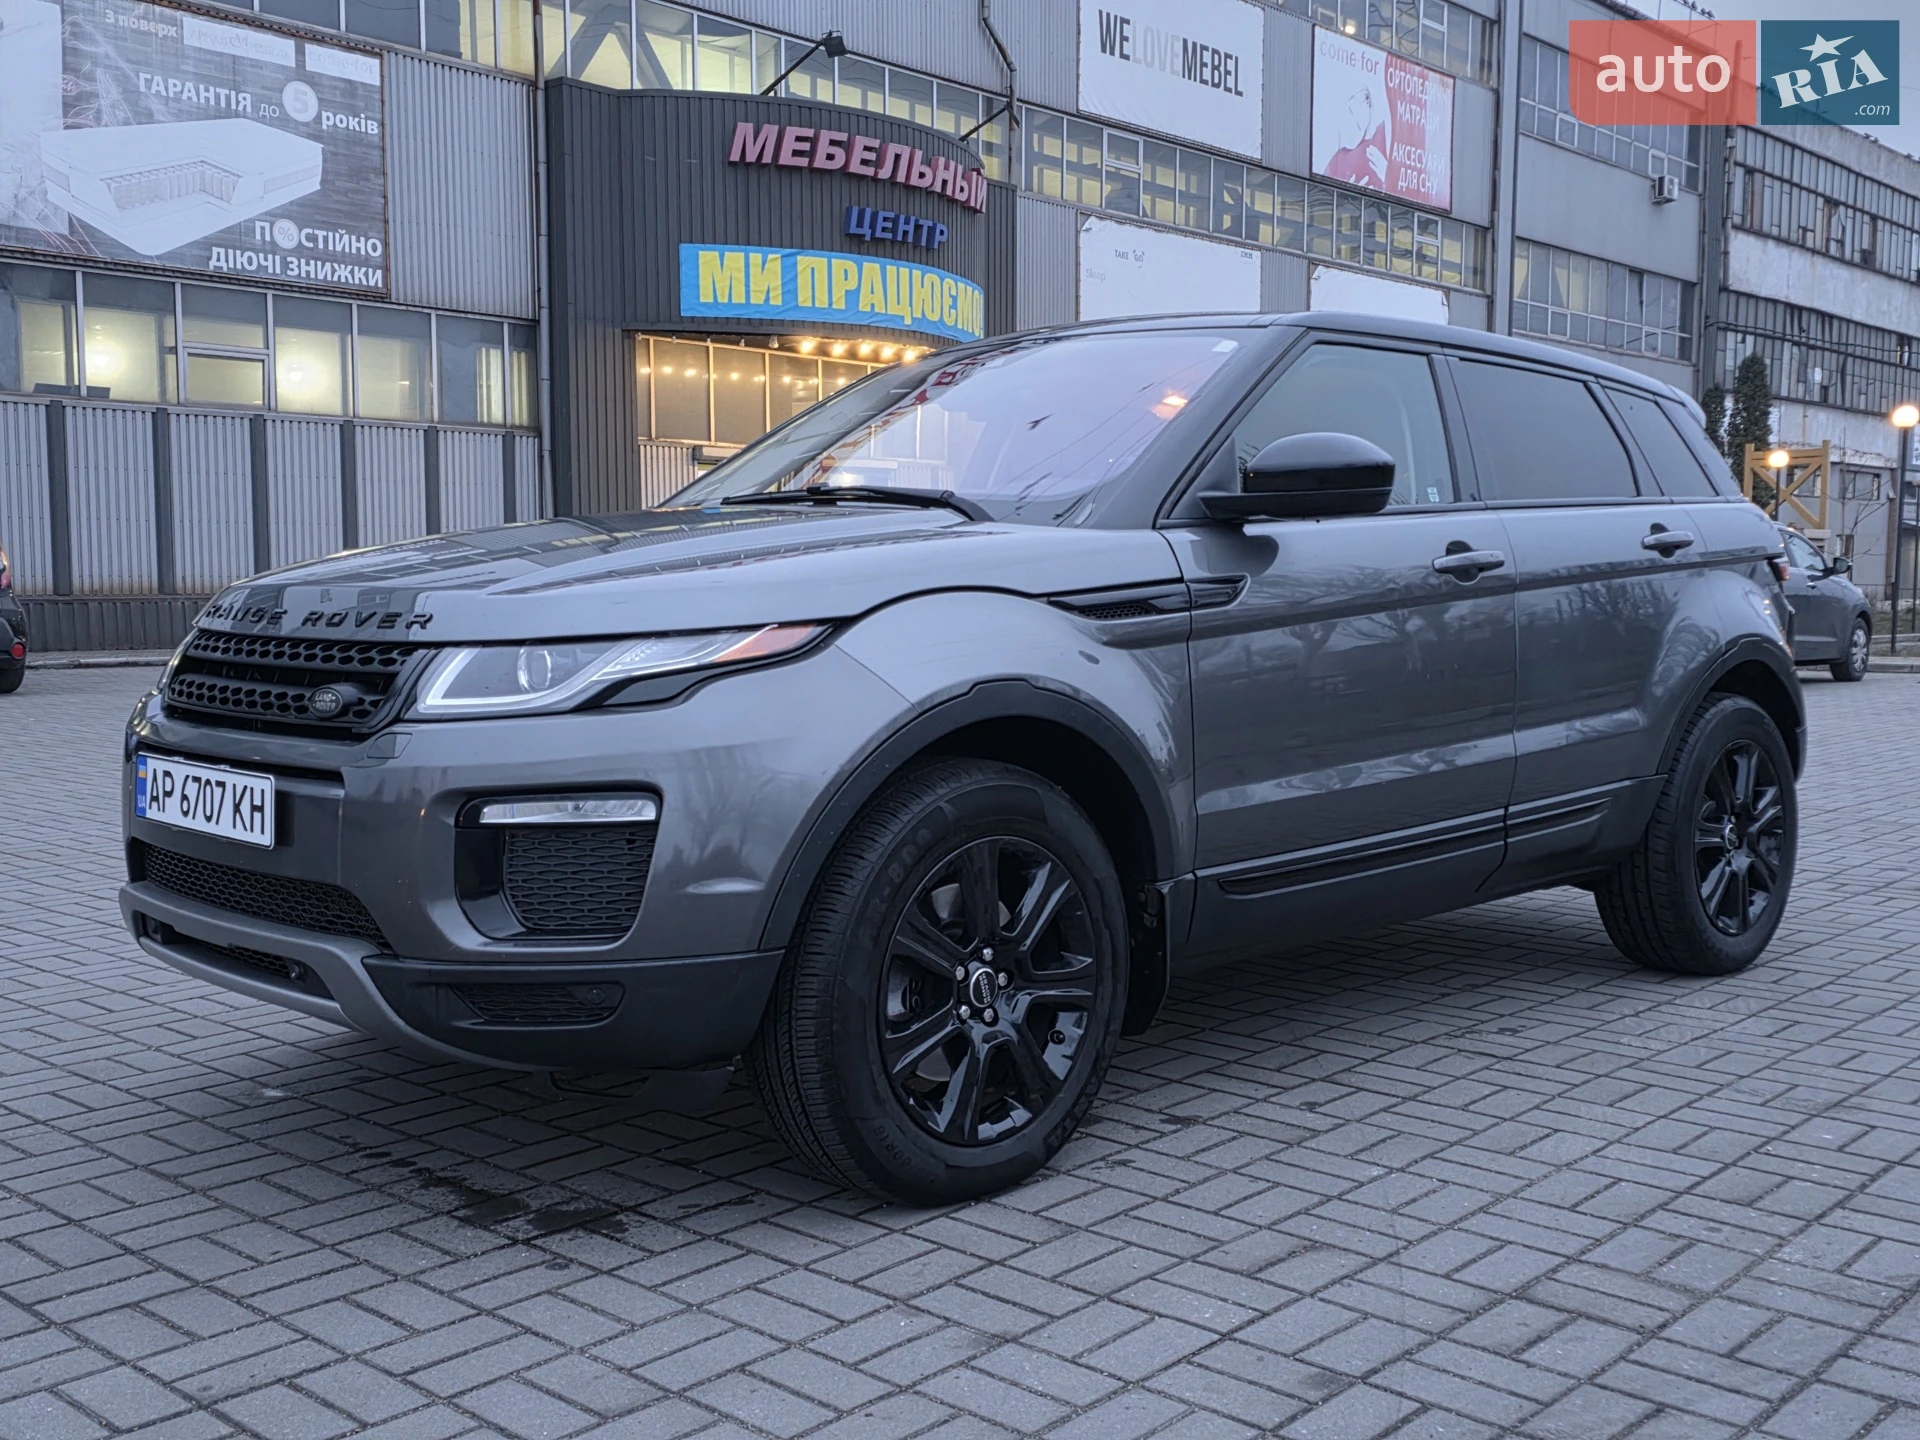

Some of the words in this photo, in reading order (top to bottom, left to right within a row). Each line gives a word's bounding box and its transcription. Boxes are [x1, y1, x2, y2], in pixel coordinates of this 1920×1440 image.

[118, 15, 178, 38] поверх
[138, 72, 252, 113] ГАРАНТІЯ
[292, 88, 310, 115] 5
[321, 109, 379, 135] років
[728, 121, 989, 214] МЕБЕЛЬНЫЙ
[1392, 142, 1445, 173] АКСЕСУАРИ
[1398, 167, 1417, 191] ДЛЯ
[1419, 173, 1438, 195] СНУ
[844, 205, 949, 250] ЦЕНТР
[208, 247, 281, 275] ДІЮЧІ
[286, 257, 383, 288] ЗНИЖКИ
[1114, 249, 1129, 262] TAKE
[698, 250, 782, 306] МИ
[796, 255, 984, 338] ПРАЦЮЄМО!
[205, 604, 288, 626] RANGE
[301, 610, 433, 630] ROVER
[149, 768, 175, 813] AP
[180, 774, 226, 825] 6707
[232, 782, 266, 835] KH
